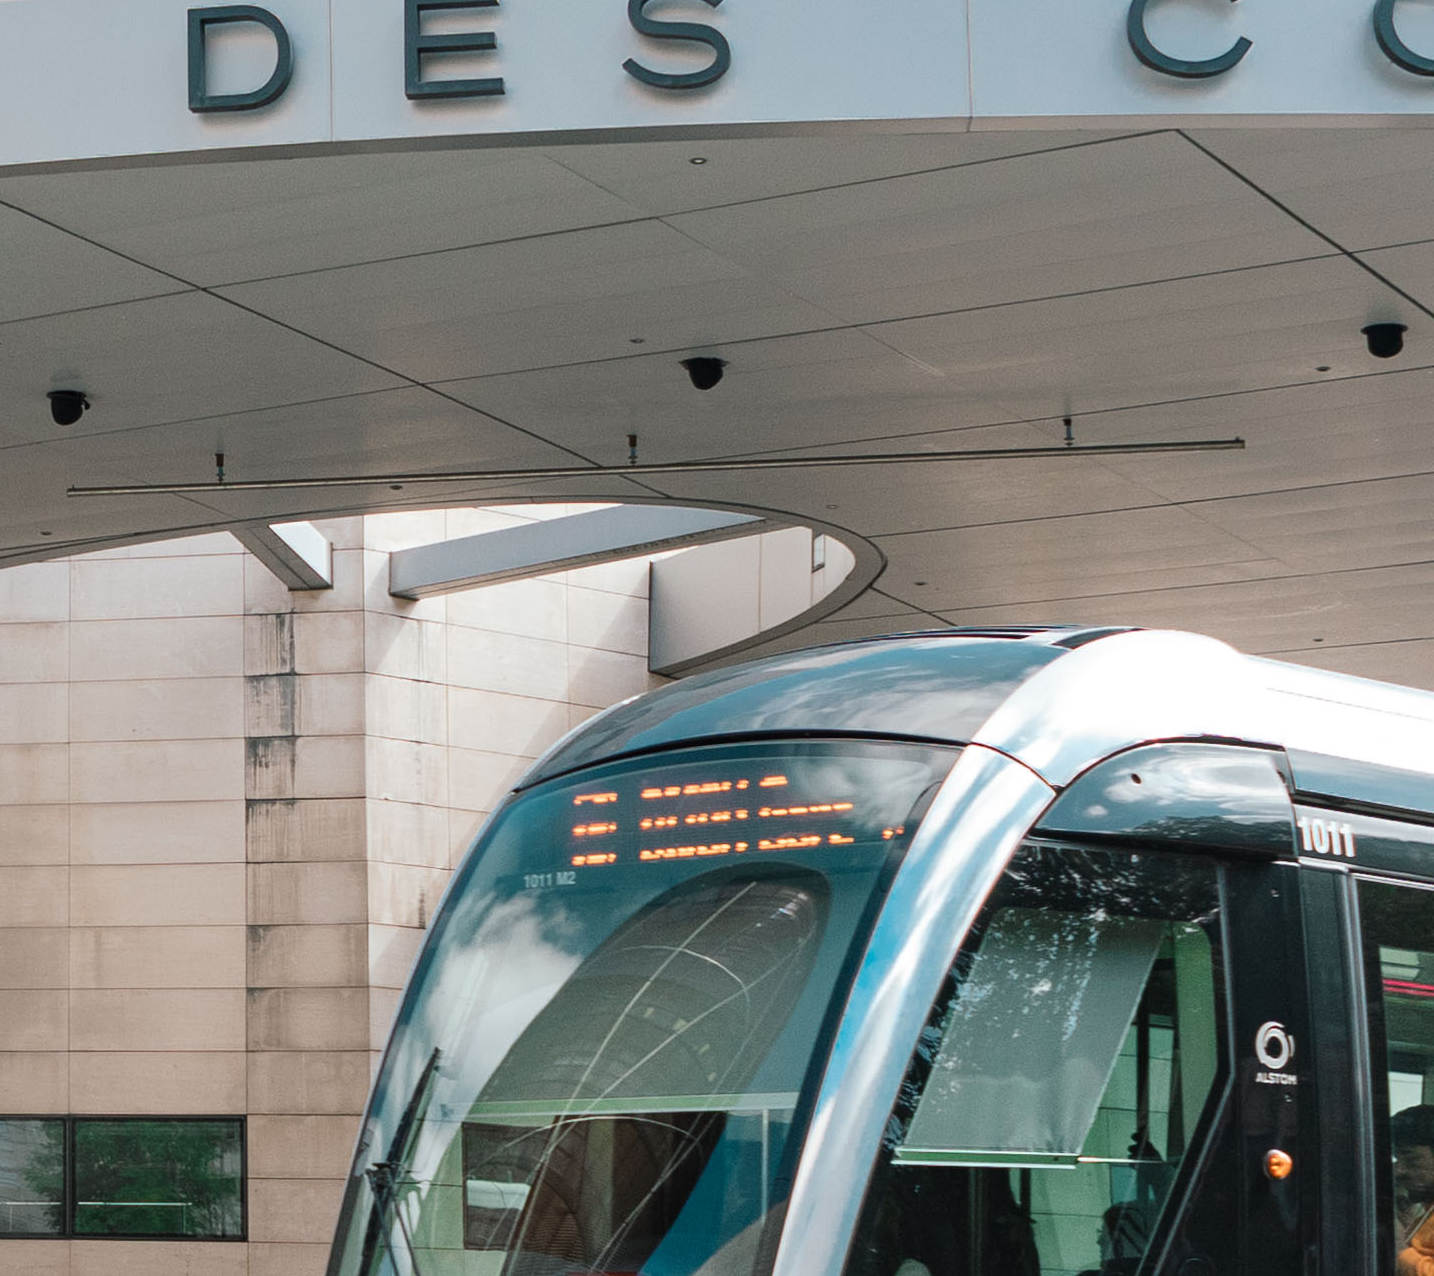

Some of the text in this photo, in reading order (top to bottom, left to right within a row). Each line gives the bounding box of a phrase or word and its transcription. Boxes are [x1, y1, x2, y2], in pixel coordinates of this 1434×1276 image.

[1297, 816, 1356, 857] 1011
[523, 871, 576, 888] 1011 M2
